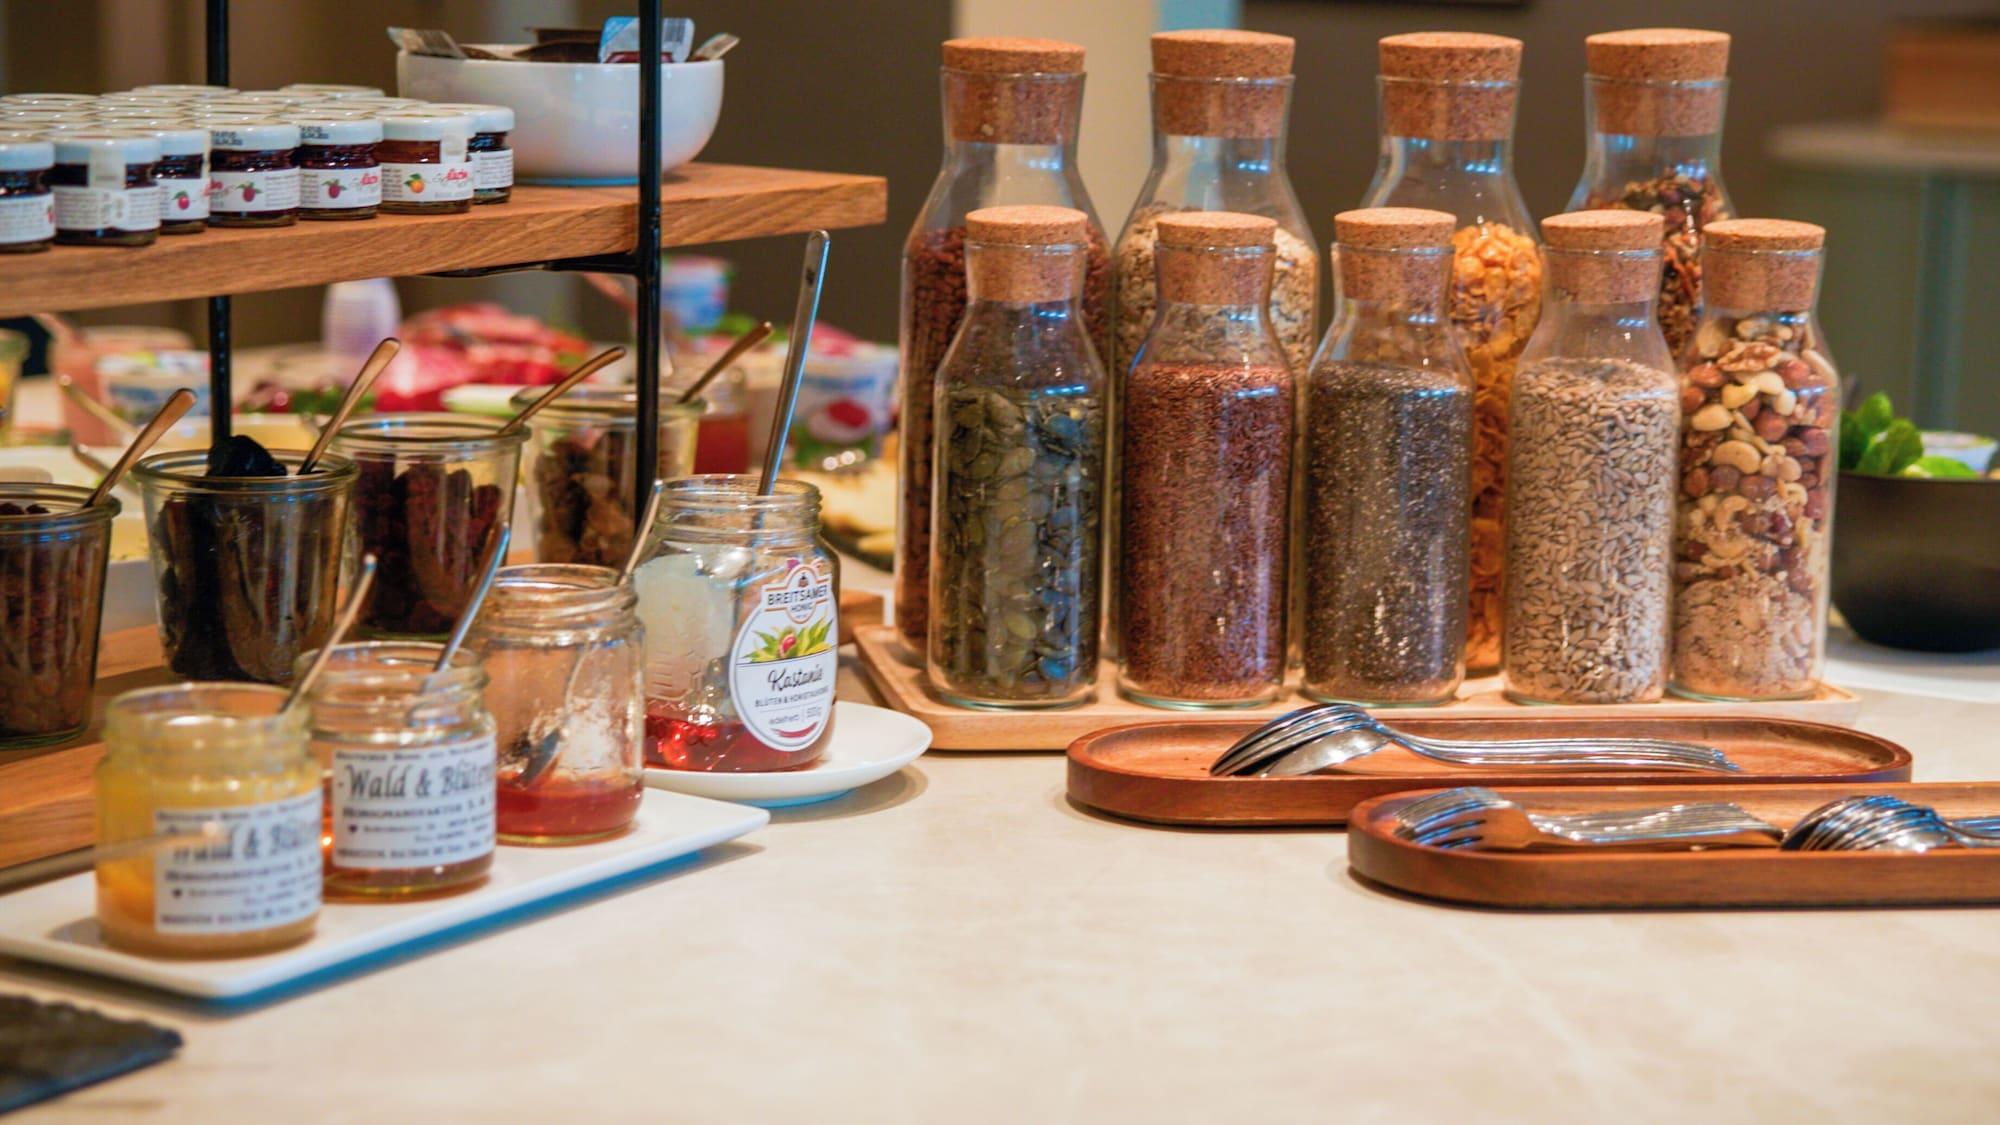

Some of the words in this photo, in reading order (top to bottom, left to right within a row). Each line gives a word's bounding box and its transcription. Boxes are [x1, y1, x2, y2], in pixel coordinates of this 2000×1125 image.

[768, 585, 827, 606] BREITSAMER
[792, 603, 812, 613] HONIG
[767, 664, 823, 692] Kastanie
[415, 768, 431, 797] &
